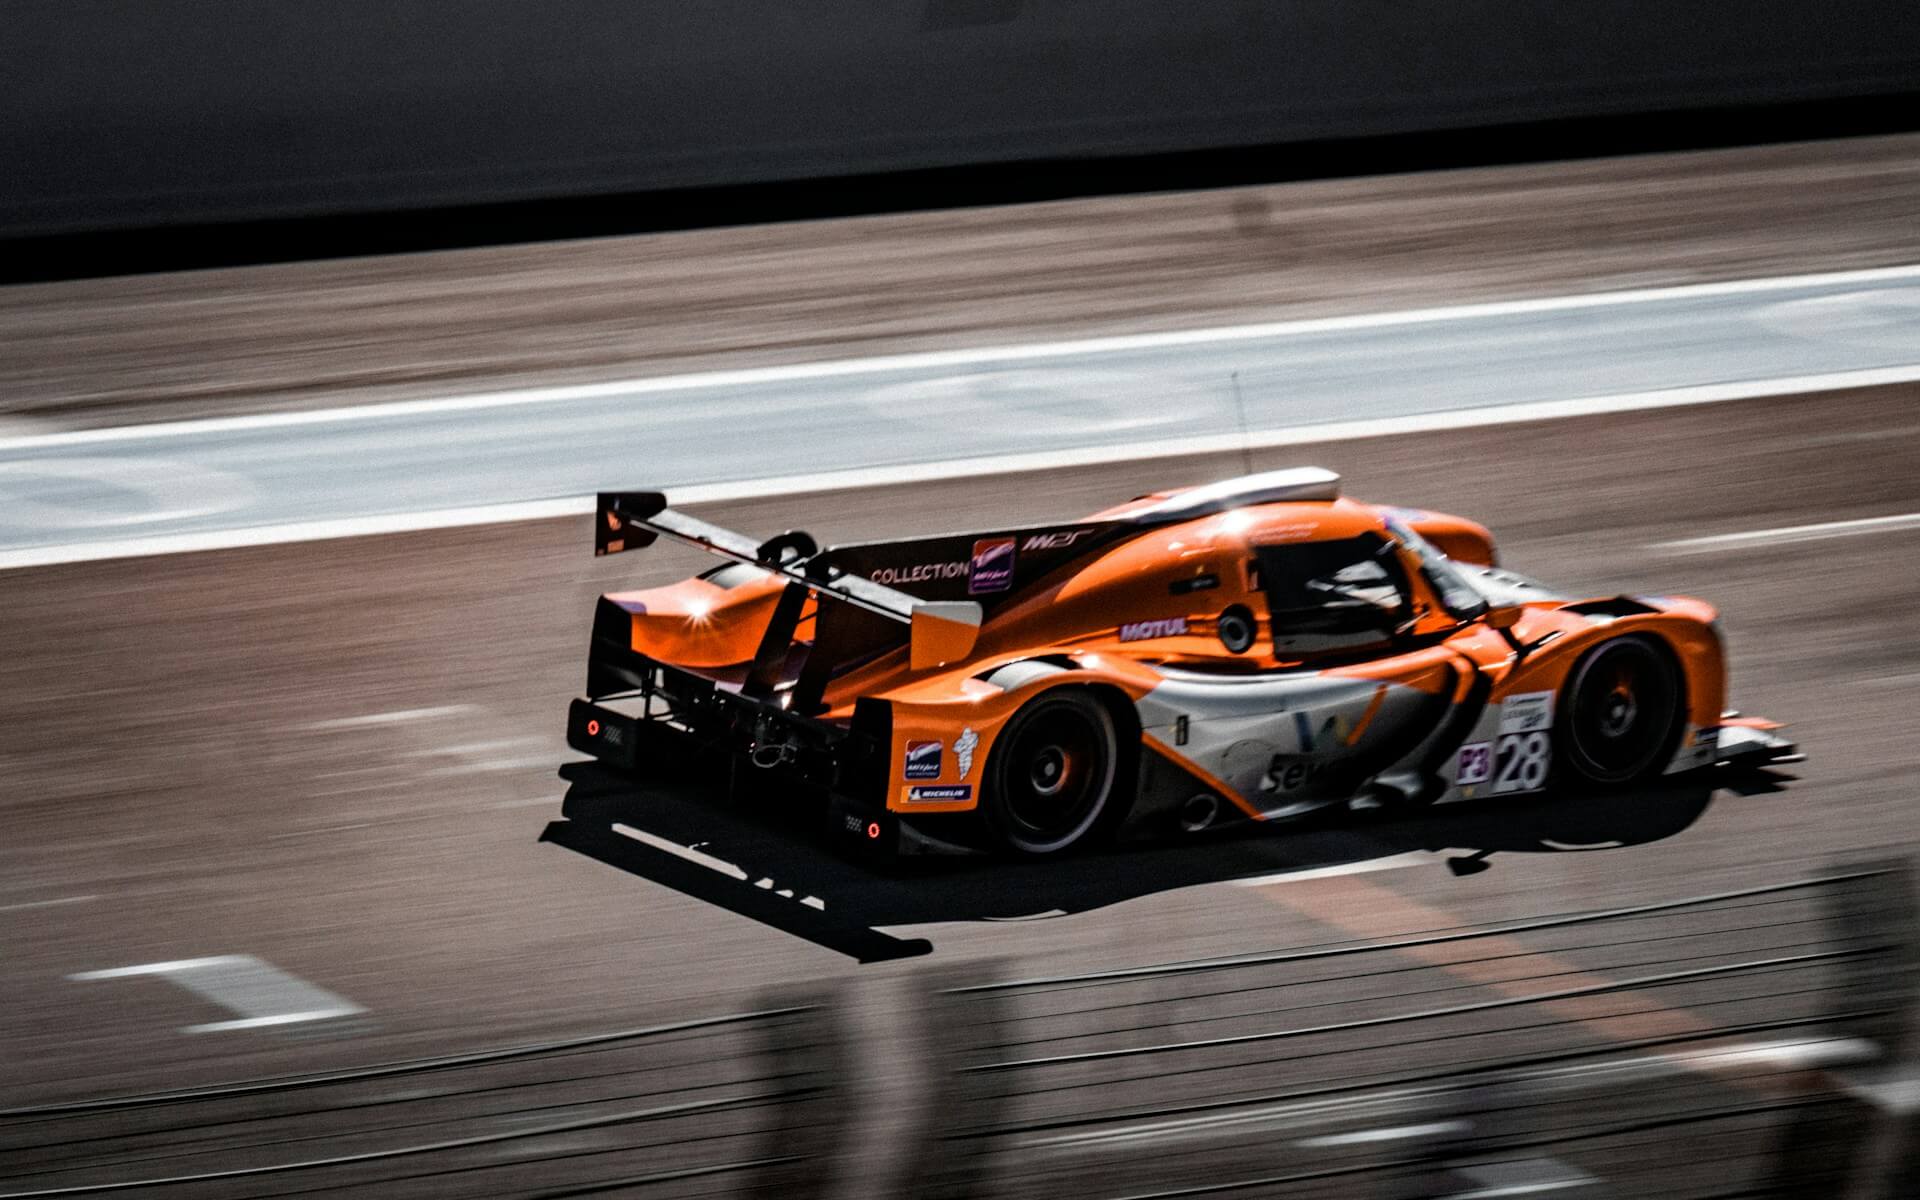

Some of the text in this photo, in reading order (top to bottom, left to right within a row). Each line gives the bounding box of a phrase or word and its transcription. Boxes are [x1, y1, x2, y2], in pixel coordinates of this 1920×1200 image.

[871, 562, 970, 585] COLLECTION
[1120, 617, 1189, 642] MOTUL
[1457, 747, 1489, 780] P3
[1492, 731, 1549, 792] 28
[922, 790, 965, 798] MICHELIN
